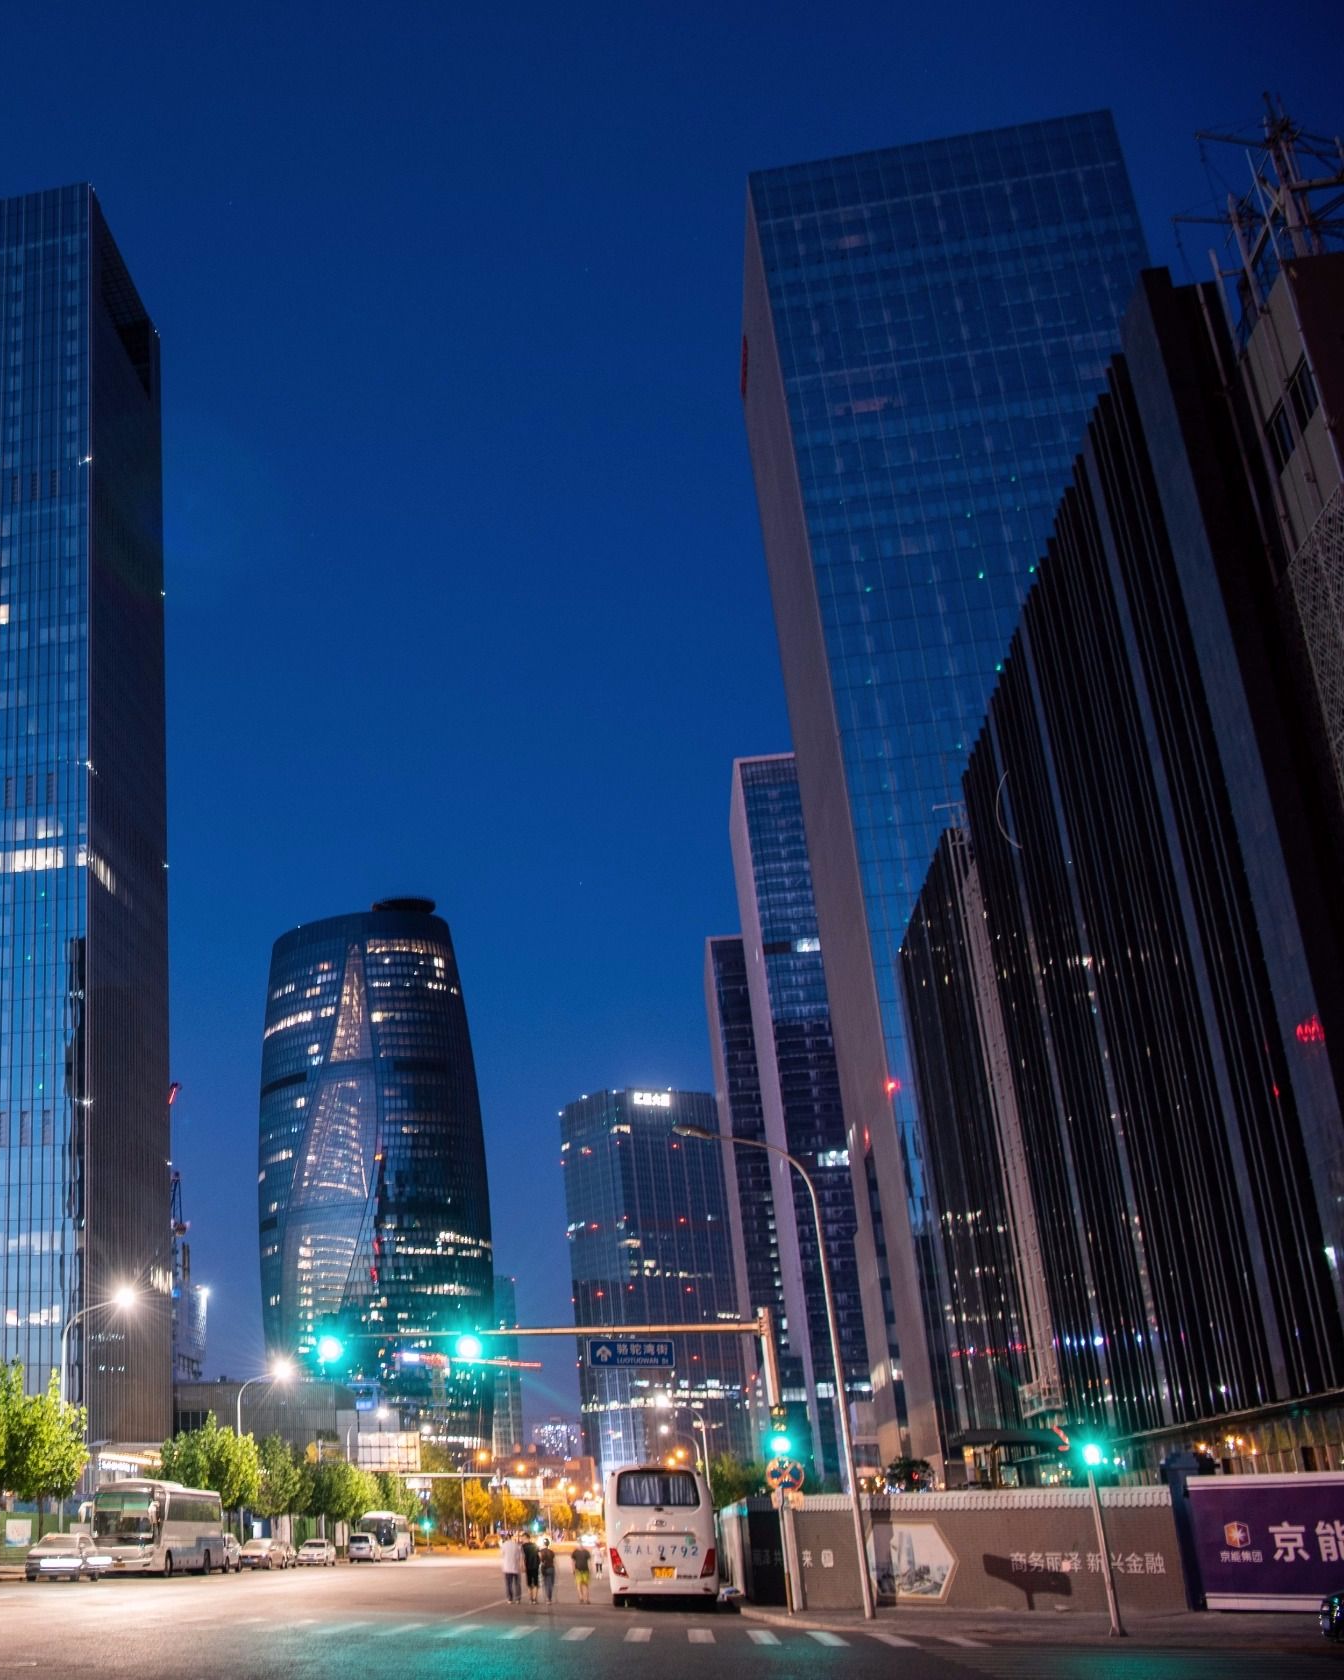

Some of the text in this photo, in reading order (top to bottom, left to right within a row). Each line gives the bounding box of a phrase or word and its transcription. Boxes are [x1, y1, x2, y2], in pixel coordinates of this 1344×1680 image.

[617, 1343, 668, 1356] 骆驼湾街
[1268, 1520, 1344, 1562] 京能
[1220, 1550, 1263, 1563] 京能集团
